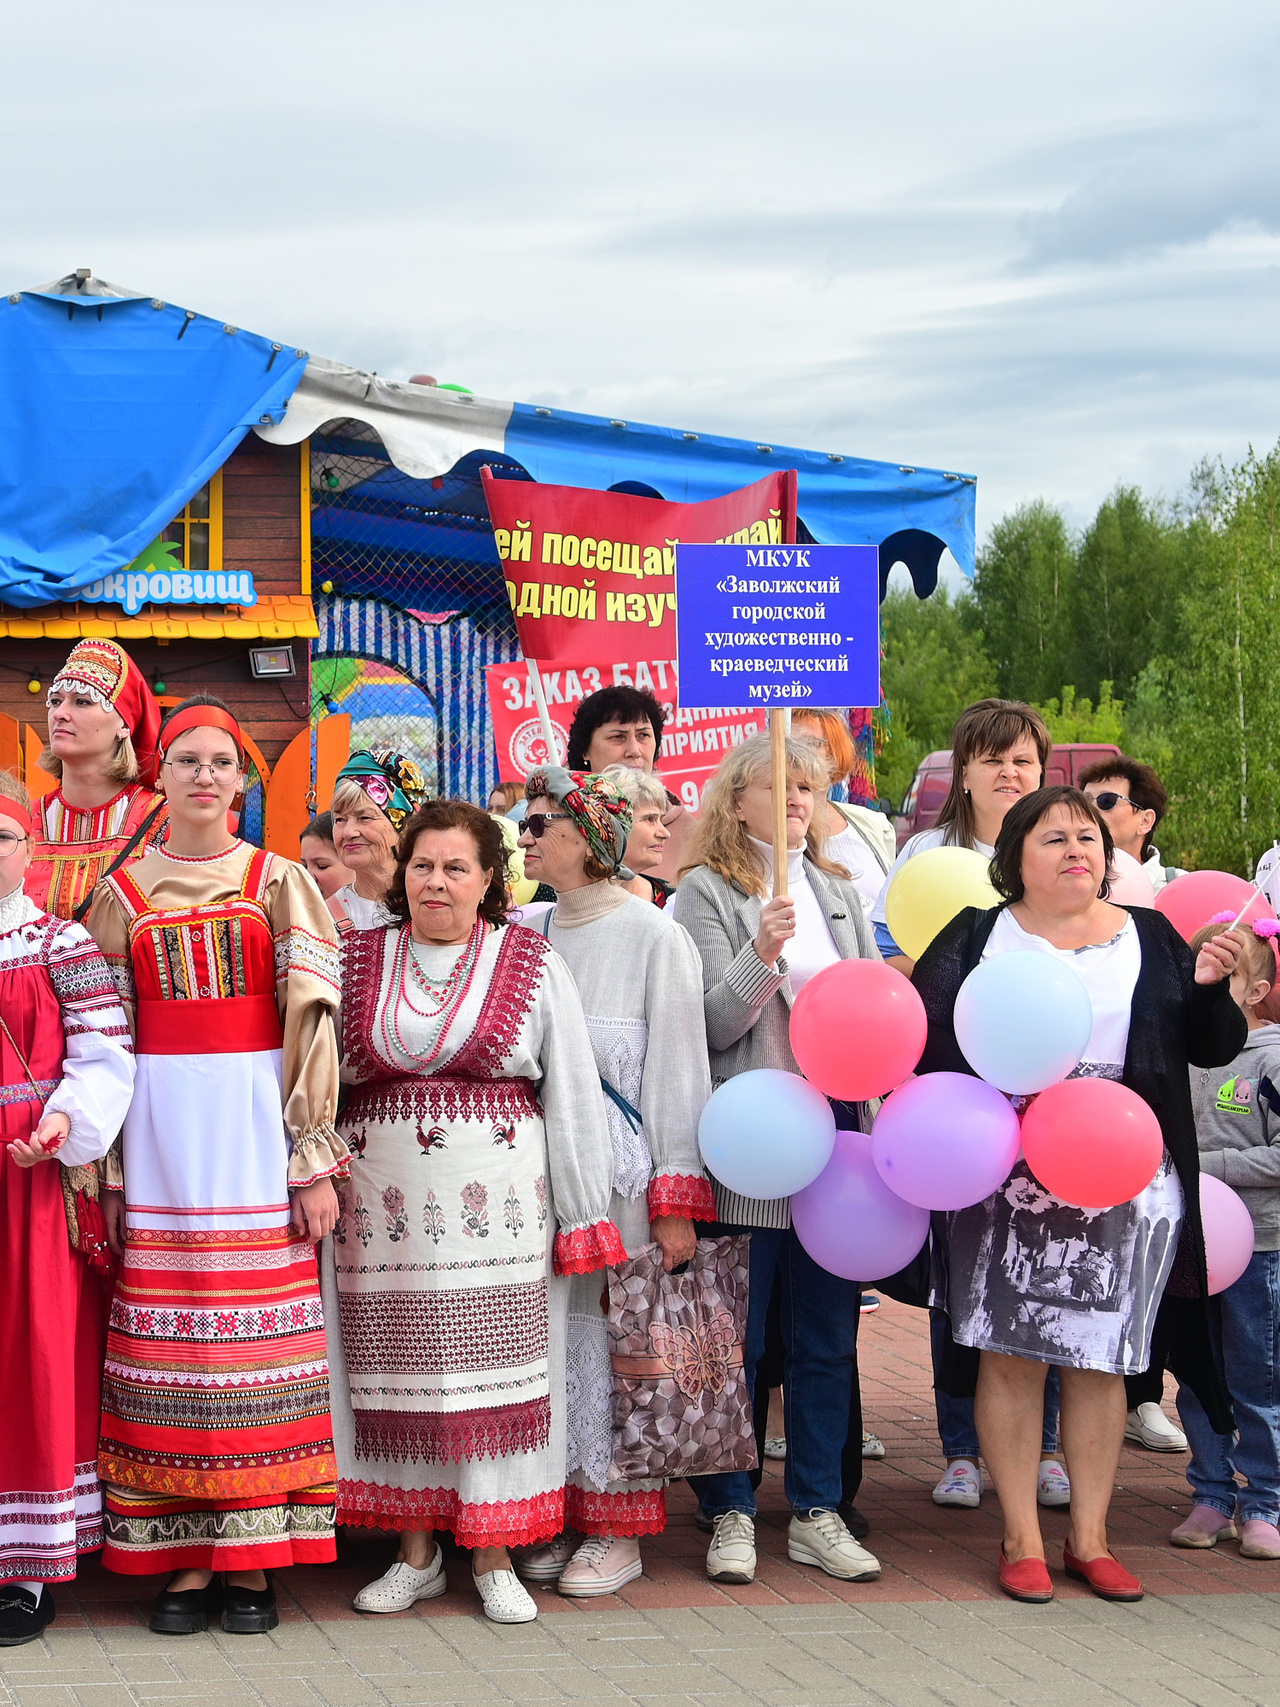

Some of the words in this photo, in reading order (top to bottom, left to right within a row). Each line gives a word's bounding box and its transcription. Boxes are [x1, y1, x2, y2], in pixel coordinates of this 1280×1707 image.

[494, 519, 533, 562] ей
[746, 549, 811, 568] МКУК
[67, 573, 254, 611] окровищ
[716, 575, 841, 594] «Заволжский
[505, 577, 597, 619] одной
[732, 602, 826, 624] городской
[705, 632, 842, 651] художественно
[710, 654, 849, 677] краеведческий
[502, 666, 603, 711] ЗАКАЗ
[749, 680, 813, 703] музей»
[660, 722, 759, 757] ПРИЯТИЯ
